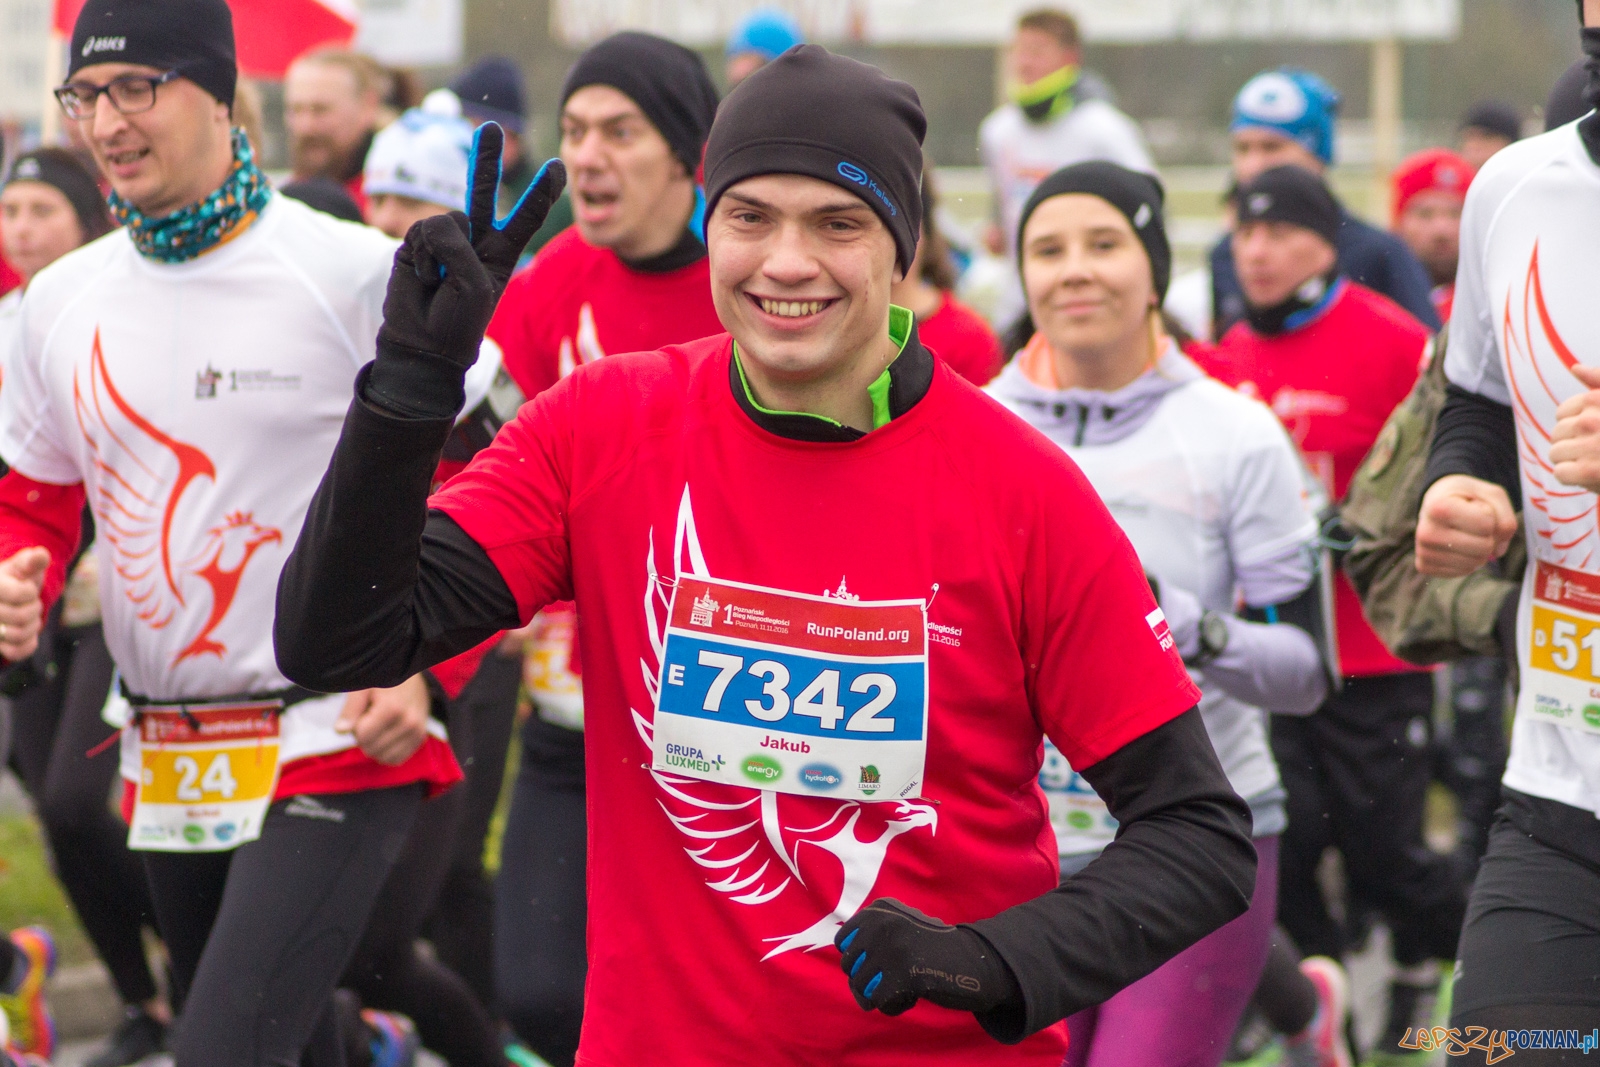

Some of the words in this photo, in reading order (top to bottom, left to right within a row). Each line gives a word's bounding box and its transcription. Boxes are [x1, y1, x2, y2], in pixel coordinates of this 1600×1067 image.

[723, 603, 733, 625] 1
[733, 612, 746, 620] Bieg
[806, 622, 910, 643] RunPoland.org
[668, 663, 685, 686] E
[697, 649, 898, 733] 7342
[666, 743, 704, 760] GRUPA
[760, 735, 811, 754] Jakub
[665, 754, 711, 773] LUXMED
[747, 765, 779, 778] energy
[173, 753, 238, 803] 24
[899, 780, 919, 798] ROGAL
